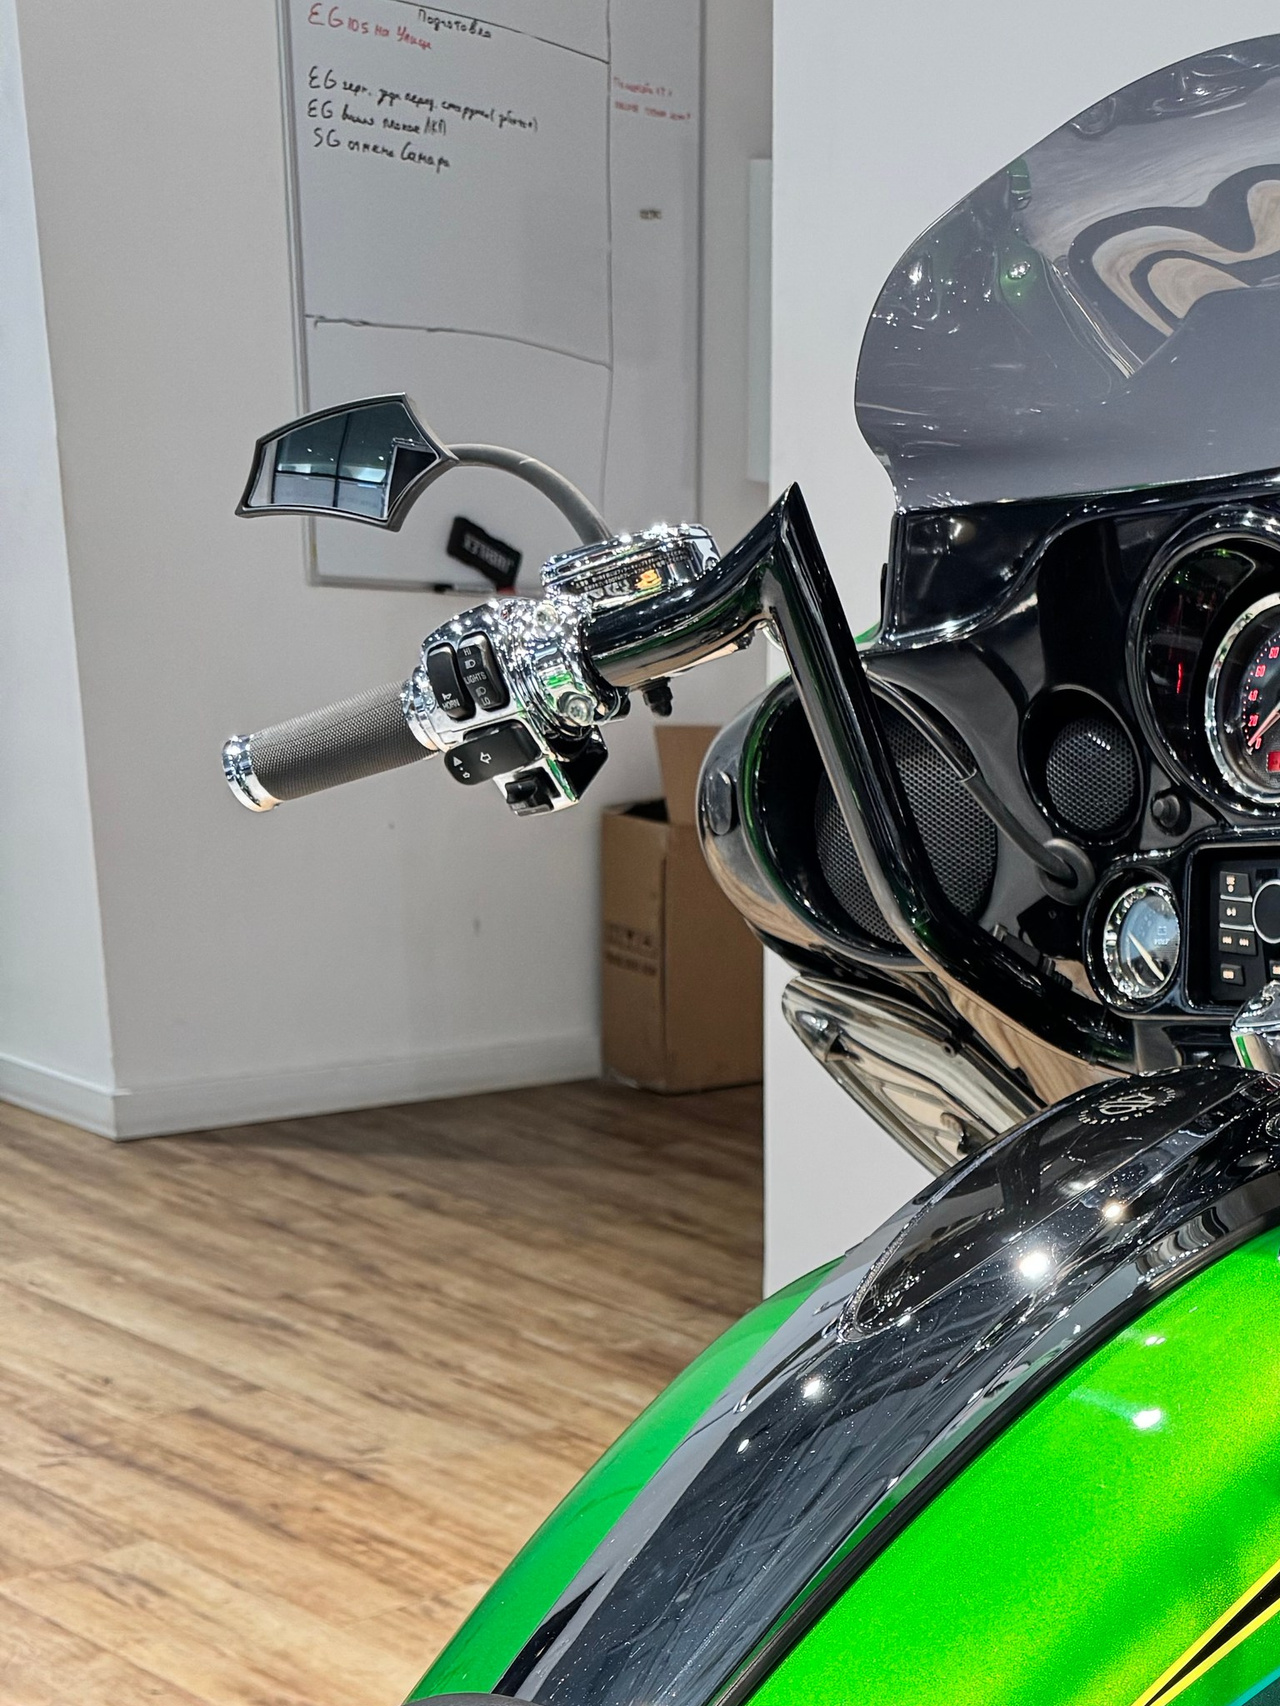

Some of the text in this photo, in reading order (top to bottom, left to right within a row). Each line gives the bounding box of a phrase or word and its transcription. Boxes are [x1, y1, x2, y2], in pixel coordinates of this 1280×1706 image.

[463, 648, 472, 656] HI
[464, 671, 487, 684] LIGHTS
[481, 696, 491, 706] LO
[1248, 690, 1259, 702] 40
[442, 698, 460, 711] HORN
[1248, 714, 1259, 727] 20
